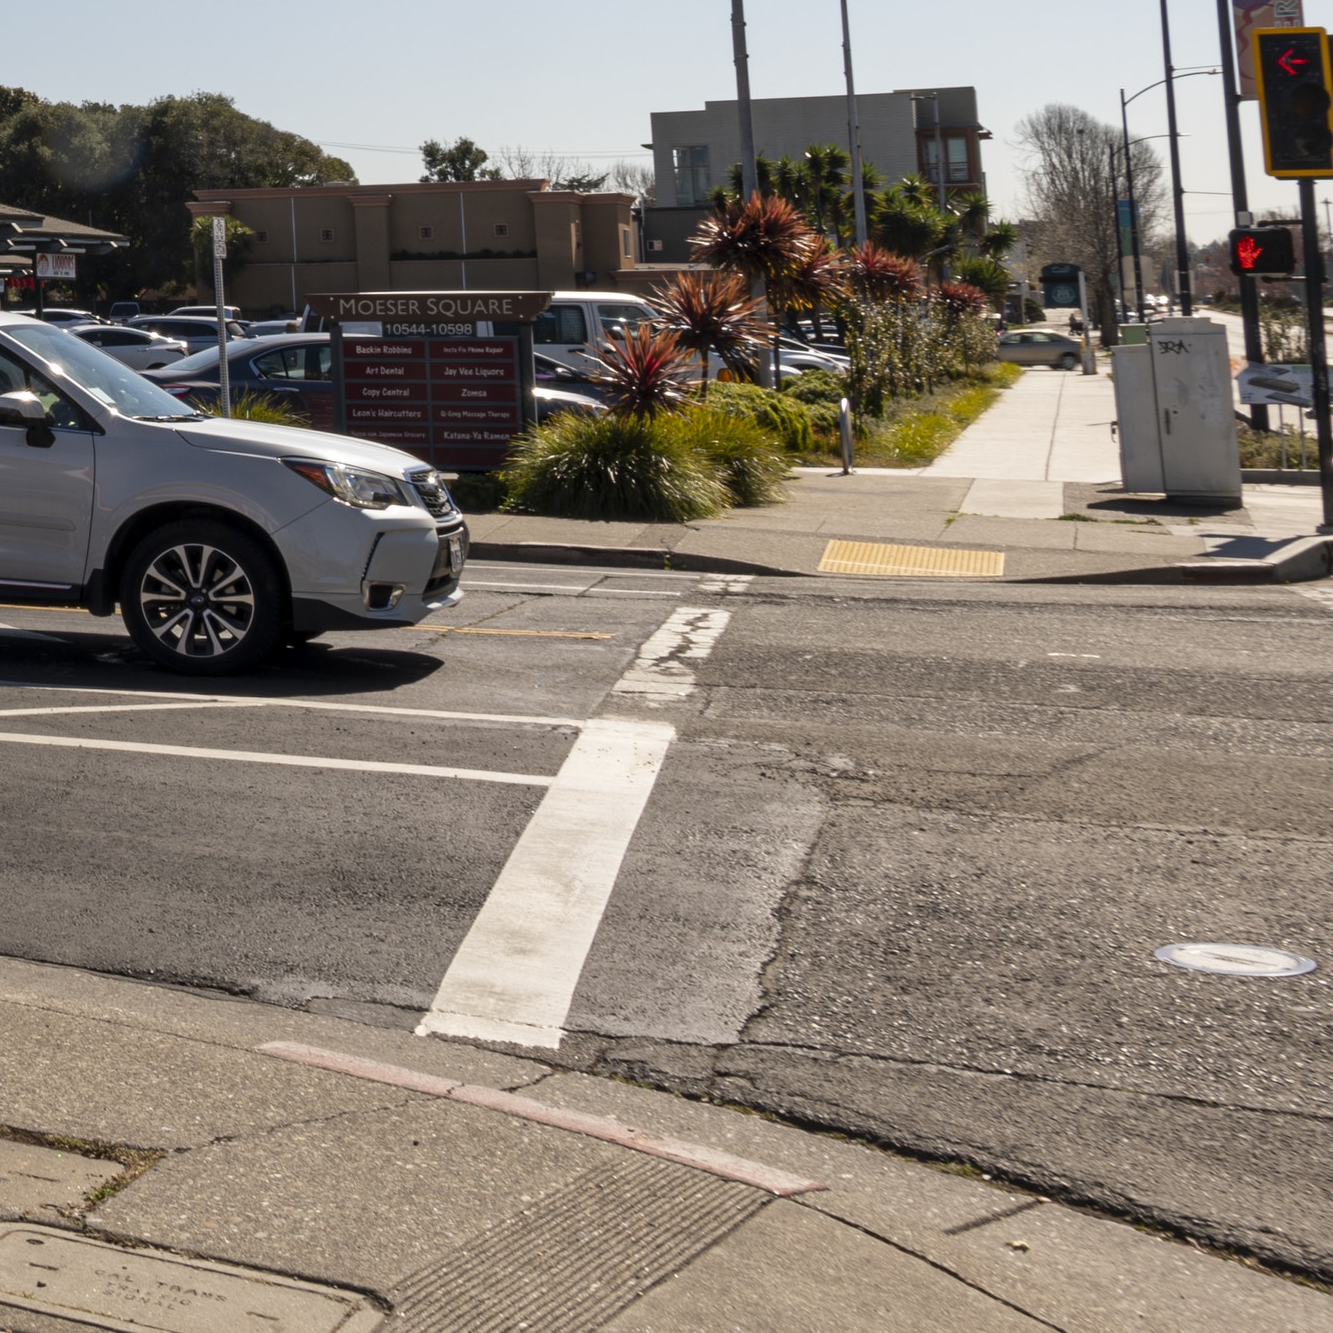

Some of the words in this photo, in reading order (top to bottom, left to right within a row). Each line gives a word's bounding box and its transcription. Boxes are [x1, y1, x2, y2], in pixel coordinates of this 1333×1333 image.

[338, 298, 421, 316] MOESER
[427, 298, 513, 317] SQUARE
[385, 323, 473, 336] 10544-10598
[355, 345, 382, 354] Baskin
[383, 345, 412, 354] Robbins
[467, 346, 485, 354] Phone
[485, 346, 504, 355] Repair
[365, 367, 378, 375] Art
[380, 367, 405, 375] Dental
[444, 367, 458, 377] Jay
[459, 367, 474, 376] Vee
[475, 367, 505, 378] Liquors
[362, 387, 381, 398] Copy
[382, 387, 410, 397] Central
[352, 408, 376, 418] Leon's
[378, 409, 422, 418] Haircutters
[488, 410, 511, 419] Therapy
[444, 431, 483, 441] Katana-Ya
[484, 431, 510, 441] Ramen
[94, 1268, 134, 1283] CAL
[157, 1280, 228, 1303] TRANS
